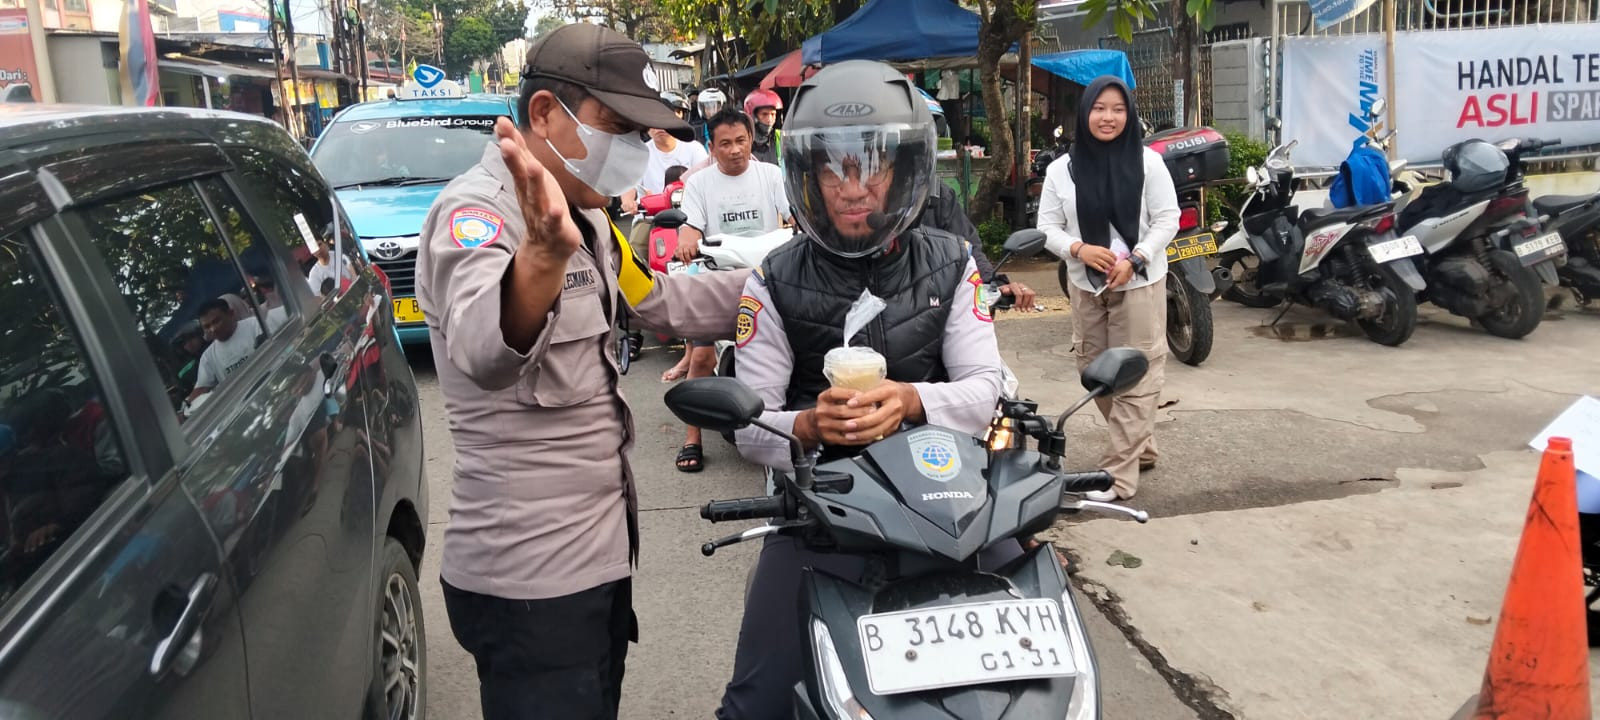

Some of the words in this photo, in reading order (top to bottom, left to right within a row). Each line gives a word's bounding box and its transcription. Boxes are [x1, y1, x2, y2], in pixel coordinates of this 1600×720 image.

[1364, 48, 1373, 82] TIME
[1457, 57, 1564, 90] HANDAL
[412, 88, 452, 97] TAKSI
[1455, 91, 1539, 128] ASLI
[385, 117, 451, 129] Bluebird
[453, 117, 494, 127] Group
[1167, 135, 1207, 152] POLISI
[722, 209, 759, 223] IGNITE
[920, 490, 974, 501] HONDA
[865, 623, 884, 652] B
[904, 611, 984, 646] 3148
